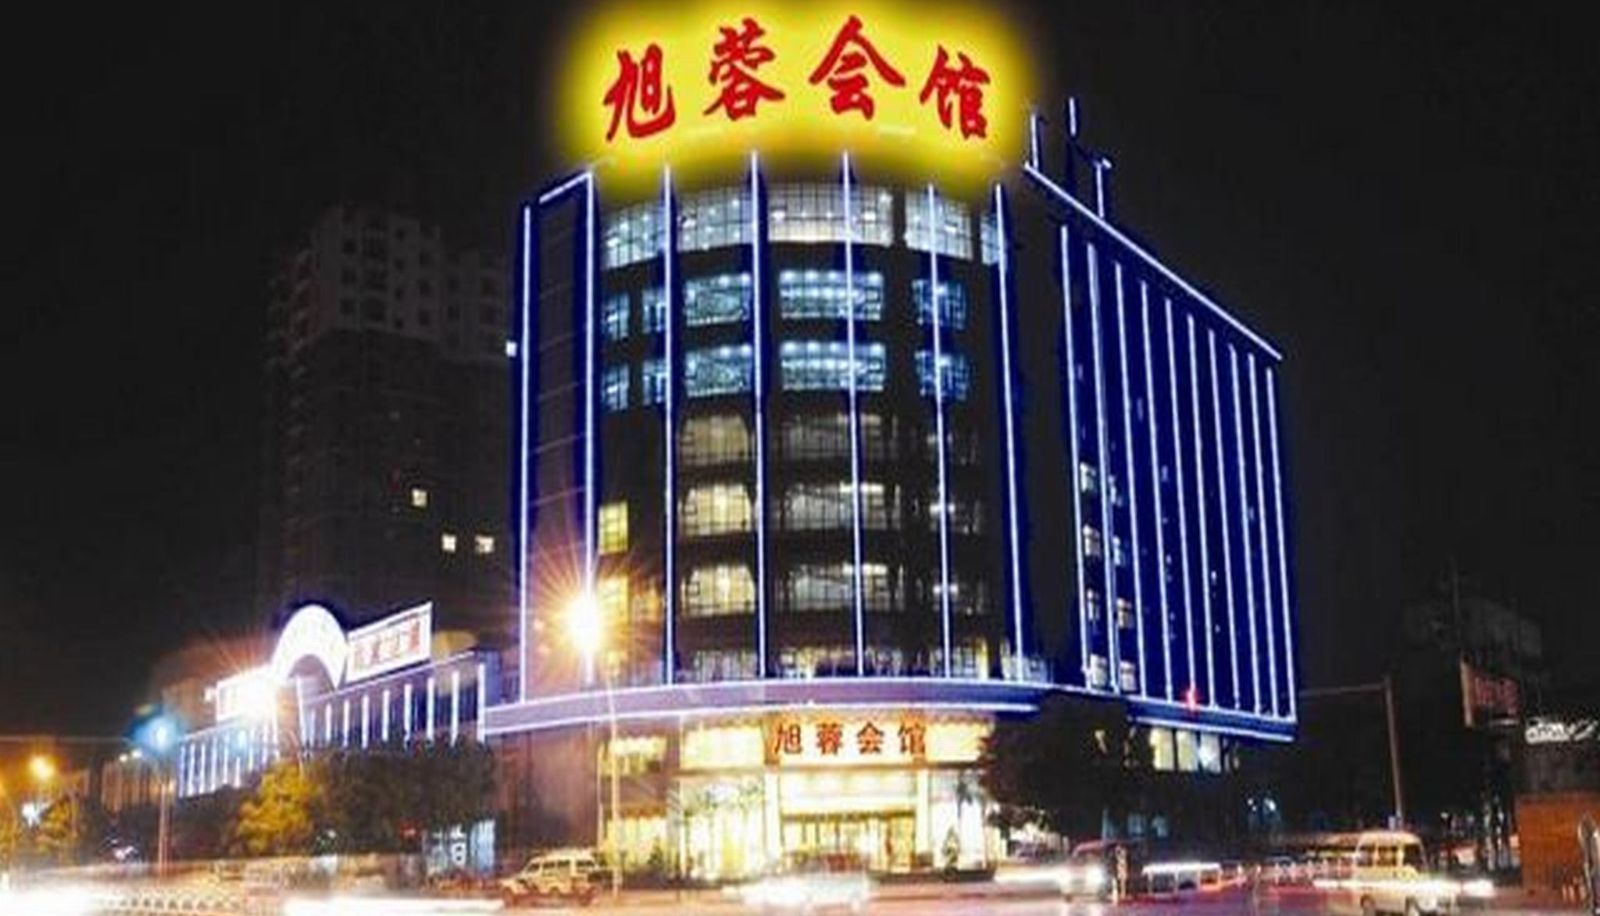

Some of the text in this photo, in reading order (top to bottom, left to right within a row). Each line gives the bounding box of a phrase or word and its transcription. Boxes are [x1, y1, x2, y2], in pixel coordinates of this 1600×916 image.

[603, 15, 991, 142] 旭蓉会馆
[774, 722, 927, 755] 旭蓉会馆
